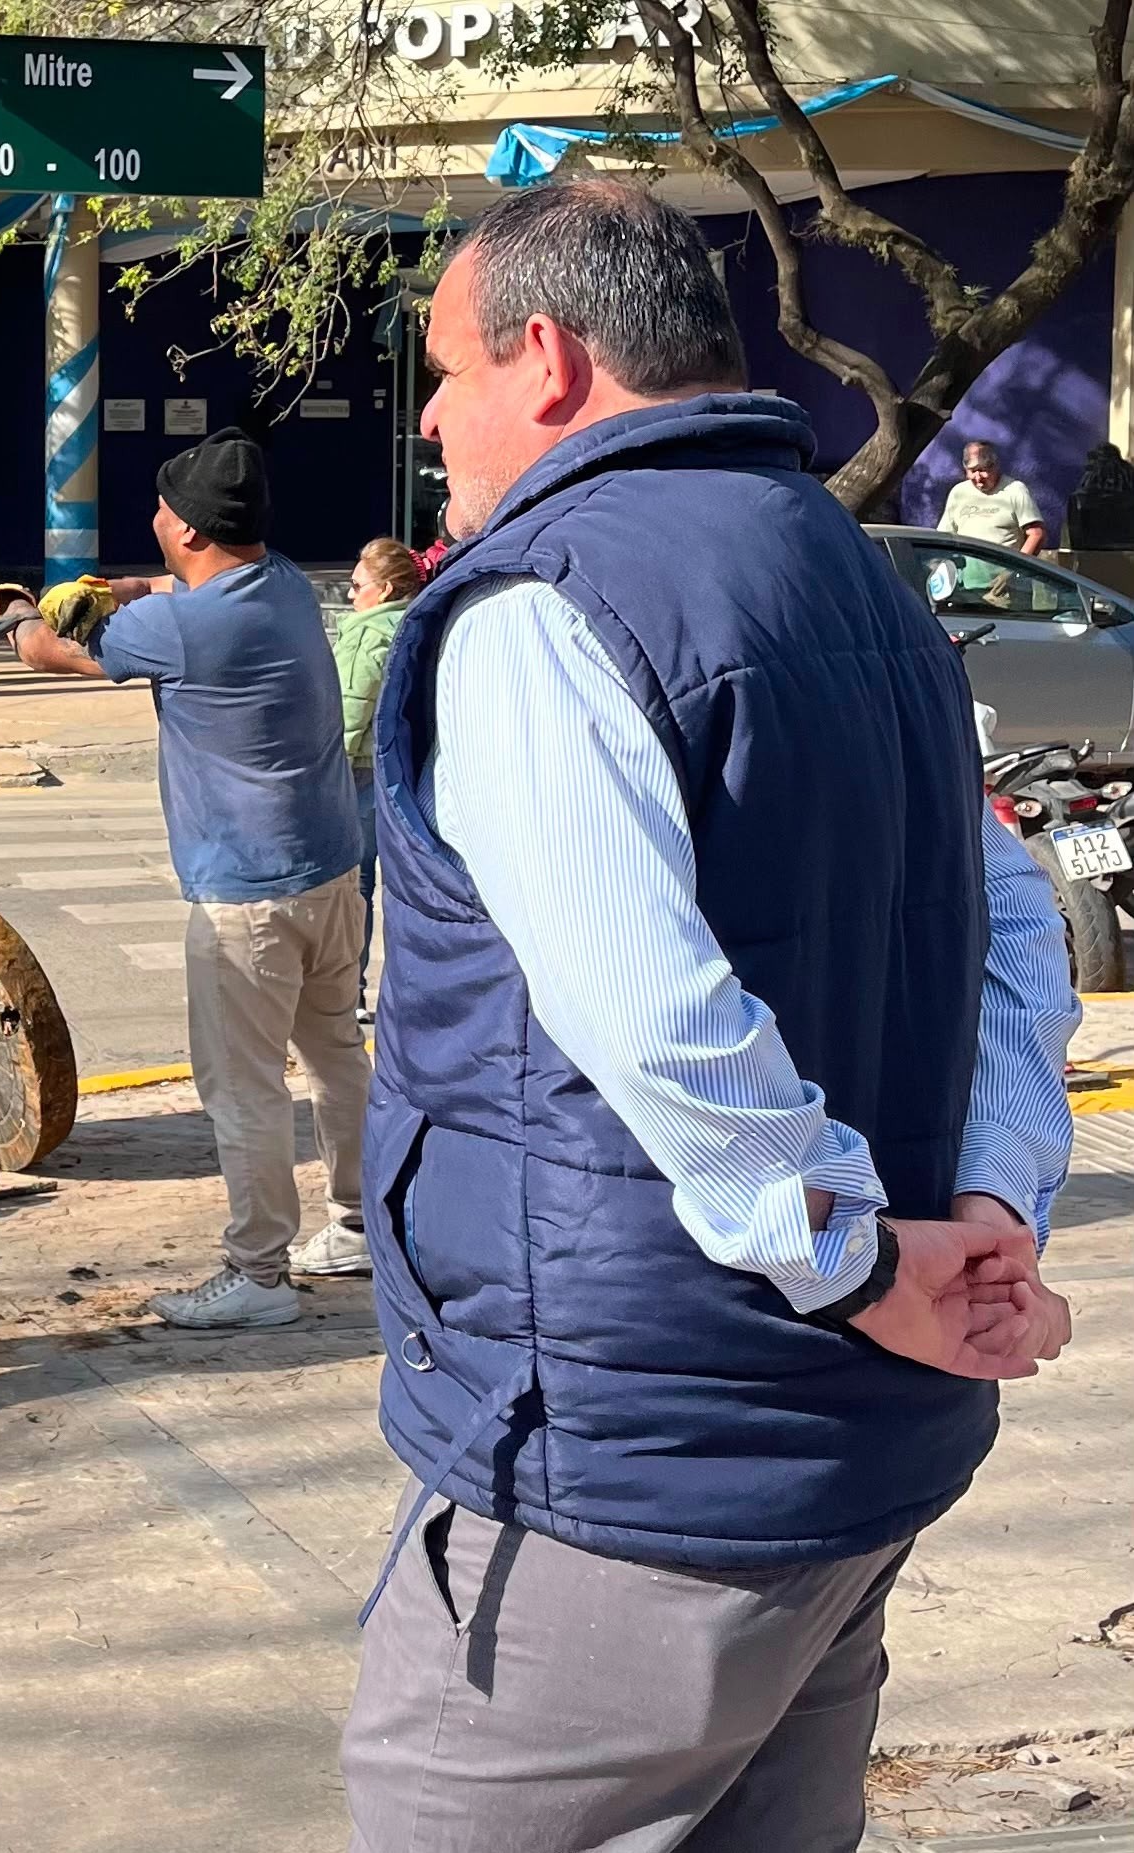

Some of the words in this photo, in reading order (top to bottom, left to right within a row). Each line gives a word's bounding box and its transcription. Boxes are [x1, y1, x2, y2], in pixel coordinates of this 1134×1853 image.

[348, 0, 703, 62] POPUAR
[24, 53, 92, 88] Mitre
[94, 148, 140, 182] 100
[1073, 833, 1110, 856] A12
